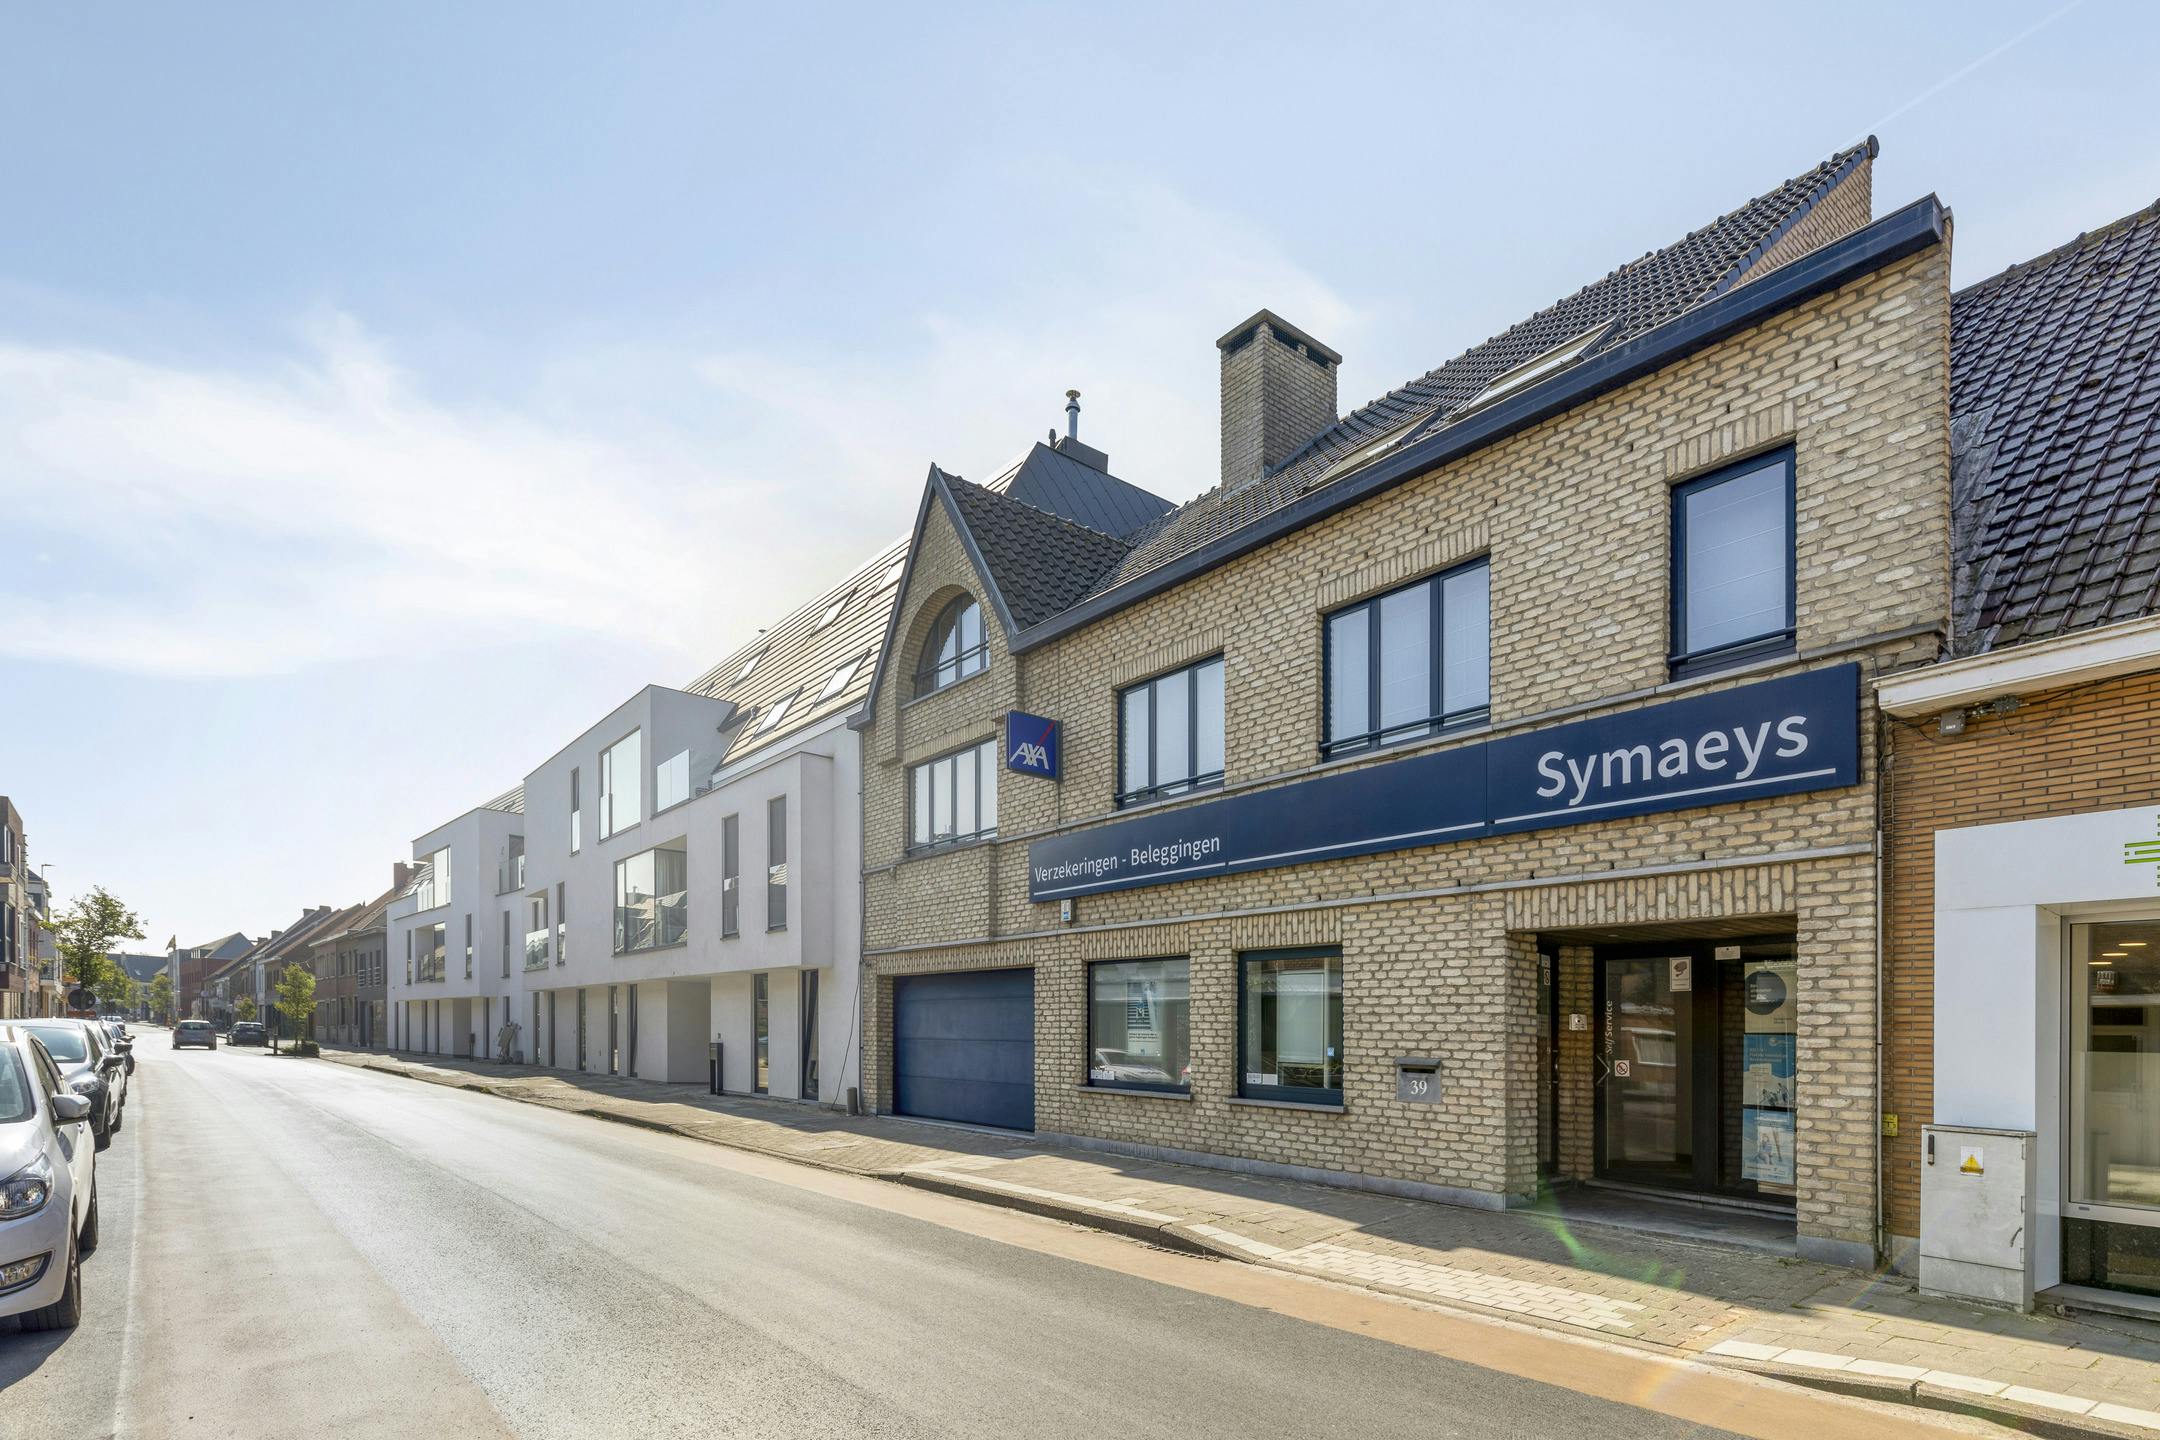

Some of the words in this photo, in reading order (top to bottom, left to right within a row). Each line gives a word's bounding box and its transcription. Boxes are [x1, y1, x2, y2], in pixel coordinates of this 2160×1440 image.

[1010, 742, 1049, 770] AXA
[1537, 715, 1809, 806] Symaeys
[1035, 856, 1118, 882] Verzekeringen
[1131, 836, 1220, 866] Beleggingen
[1605, 1001, 1613, 1037] Service
[1410, 1080, 1427, 1095] 39
